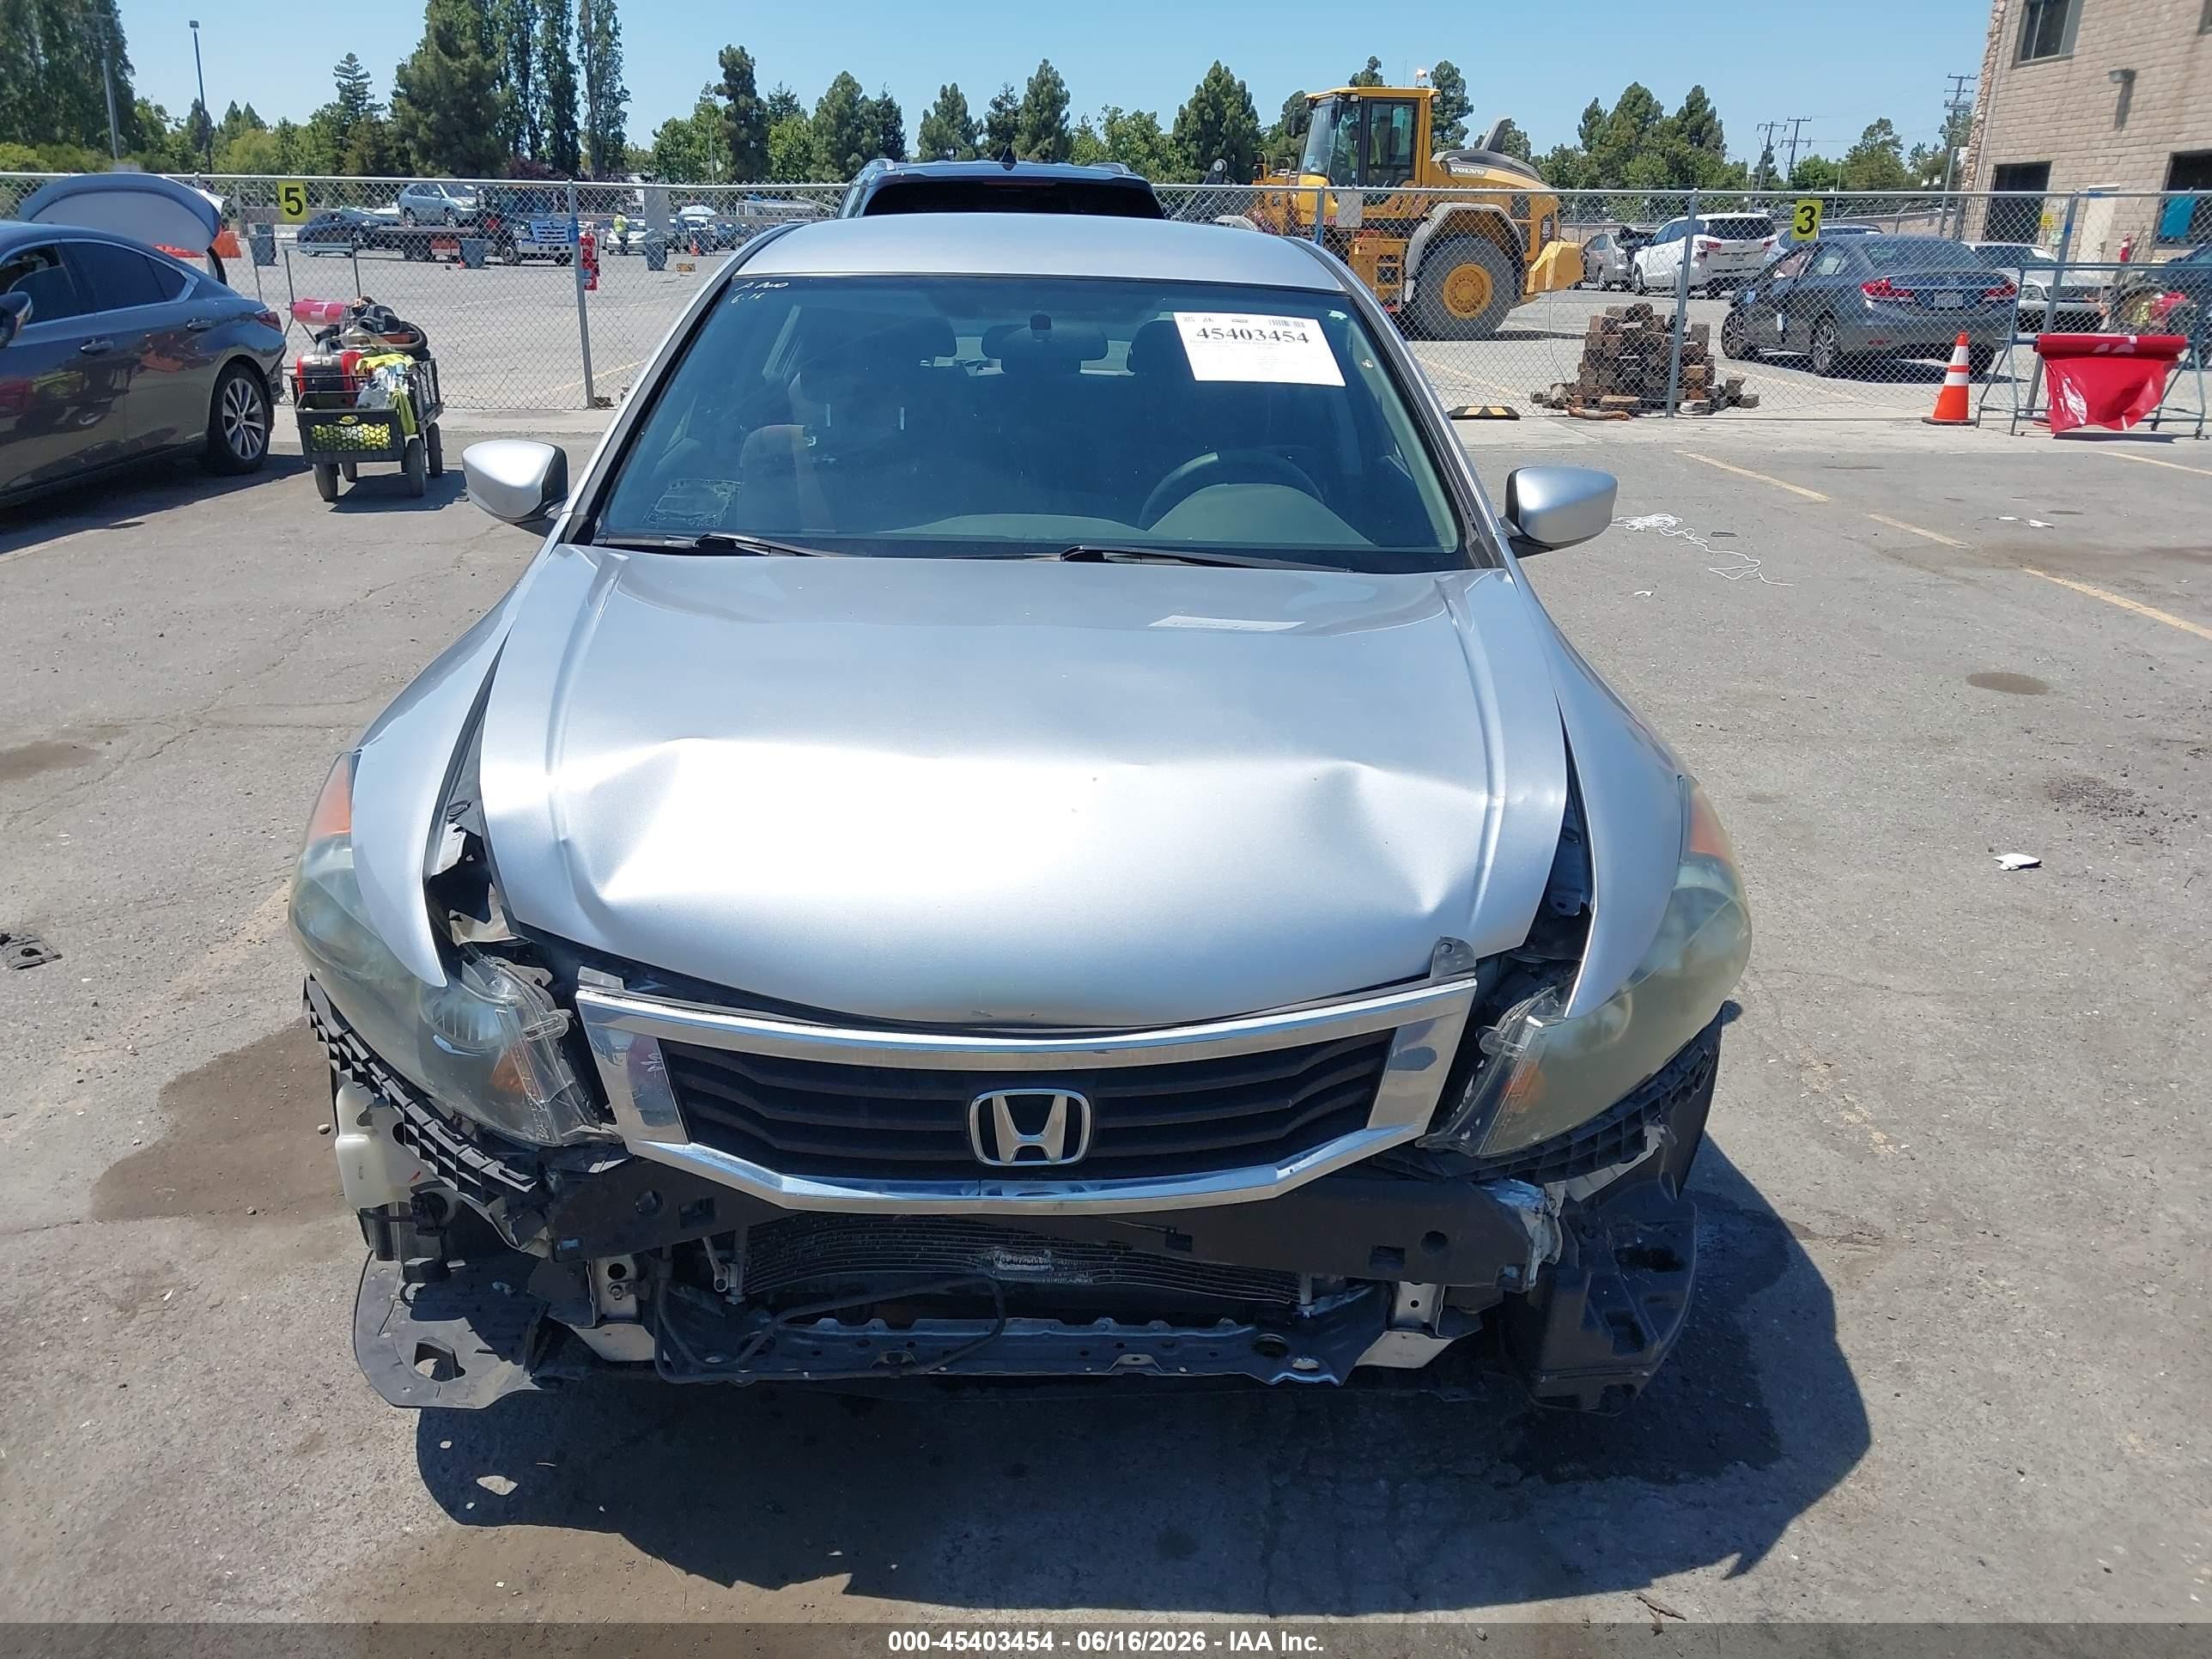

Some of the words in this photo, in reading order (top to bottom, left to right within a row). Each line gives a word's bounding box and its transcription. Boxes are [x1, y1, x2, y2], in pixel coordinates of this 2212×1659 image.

[284, 186, 303, 216] 5
[1796, 205, 1816, 234] 3
[1196, 327, 1310, 344] 45403454
